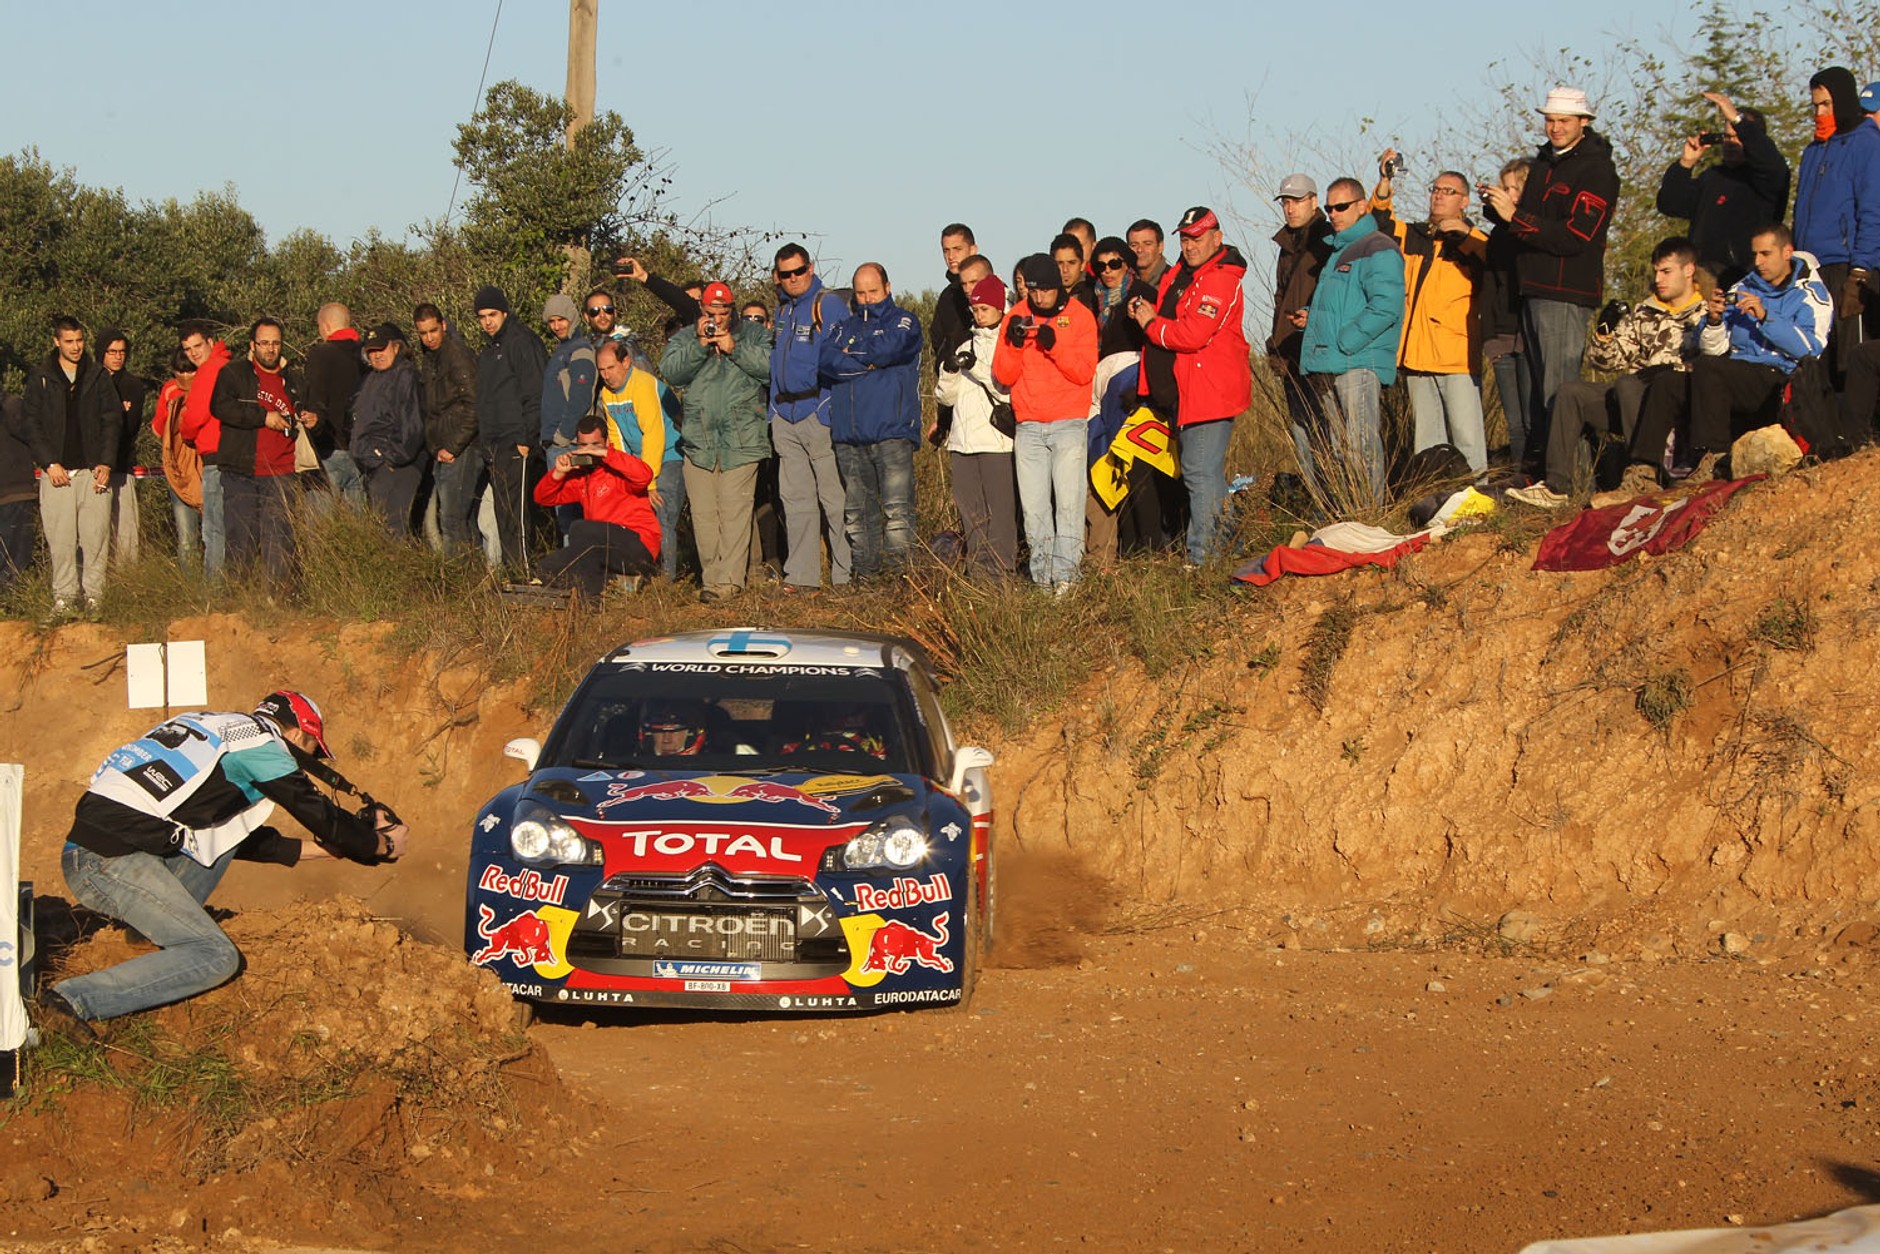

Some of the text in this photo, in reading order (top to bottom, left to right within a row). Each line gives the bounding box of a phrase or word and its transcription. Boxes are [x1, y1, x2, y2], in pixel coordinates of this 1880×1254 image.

[1185, 211, 1196, 224] 1
[651, 663, 850, 676] WORLD CHAMPIONS
[146, 765, 173, 788] WRC
[622, 830, 802, 862] TOTAL
[680, 964, 756, 975] MICHELIN
[572, 991, 634, 1003] LUHTA
[795, 997, 857, 1006] LUHTA
[874, 988, 962, 1005] EURODATACAR
